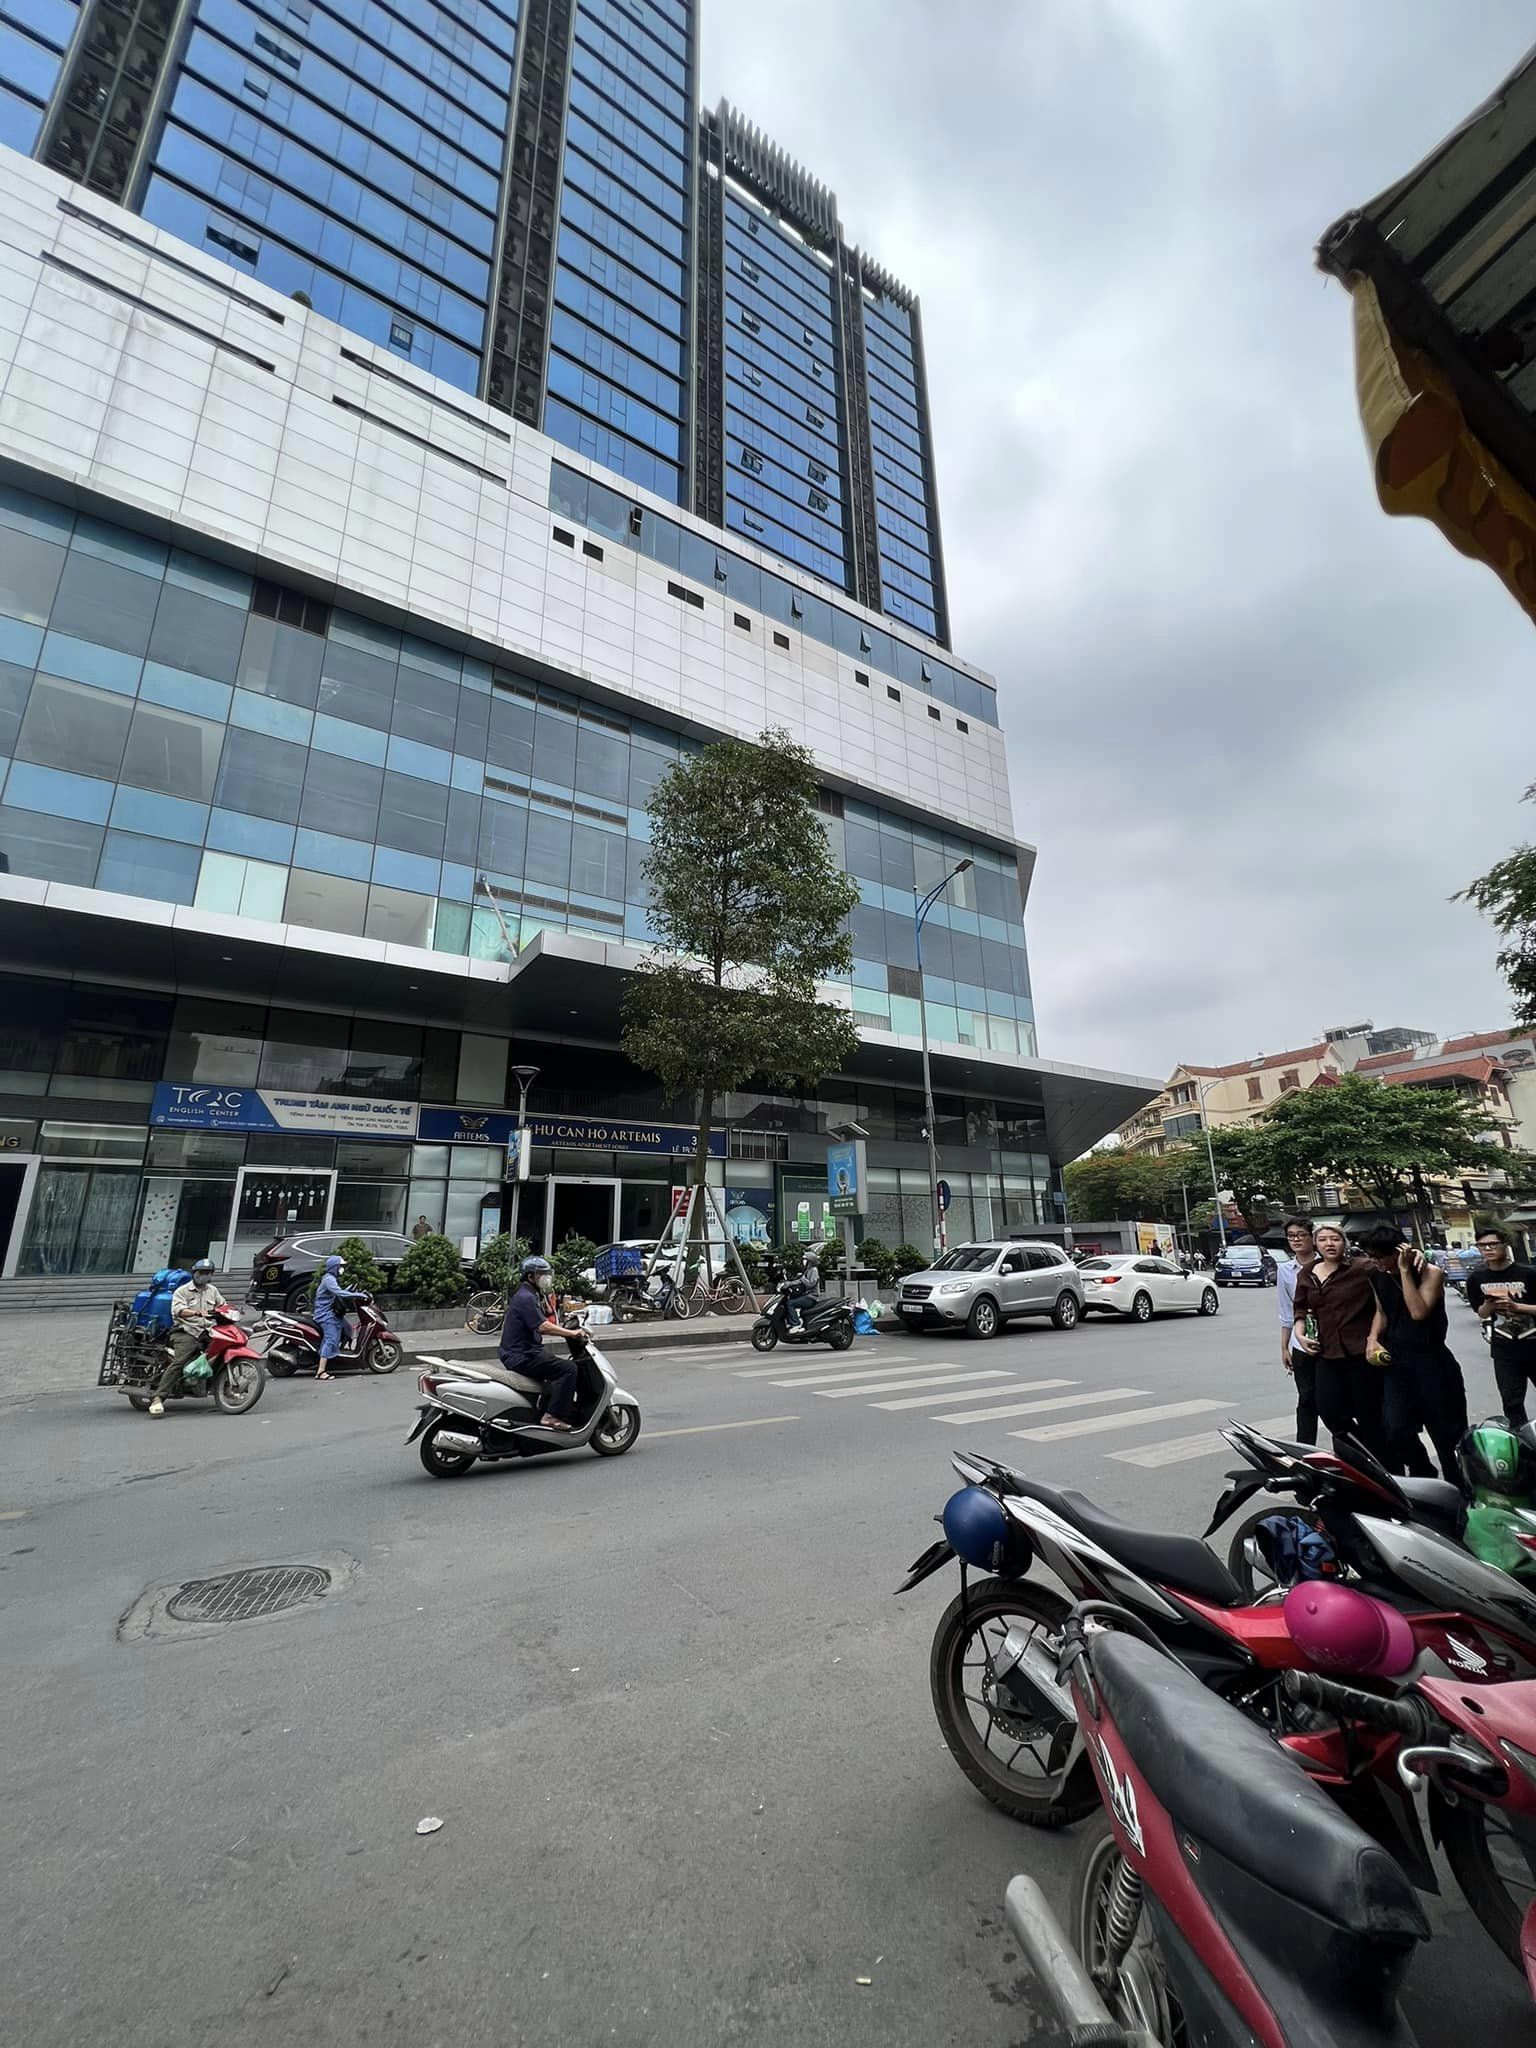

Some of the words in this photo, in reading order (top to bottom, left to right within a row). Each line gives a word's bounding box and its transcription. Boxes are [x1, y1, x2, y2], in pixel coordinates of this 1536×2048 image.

[169, 1106, 204, 1115] ENGLISH
[209, 1109, 239, 1117] CENTER
[309, 1099, 329, 1109] TÂM
[330, 1102, 350, 1111] ANH
[372, 1104, 398, 1114] QUỐC
[454, 1131, 490, 1141] ARTEMIS
[610, 1130, 661, 1144] ARTEMIS
[1447, 1658, 1488, 1677] HONDA
